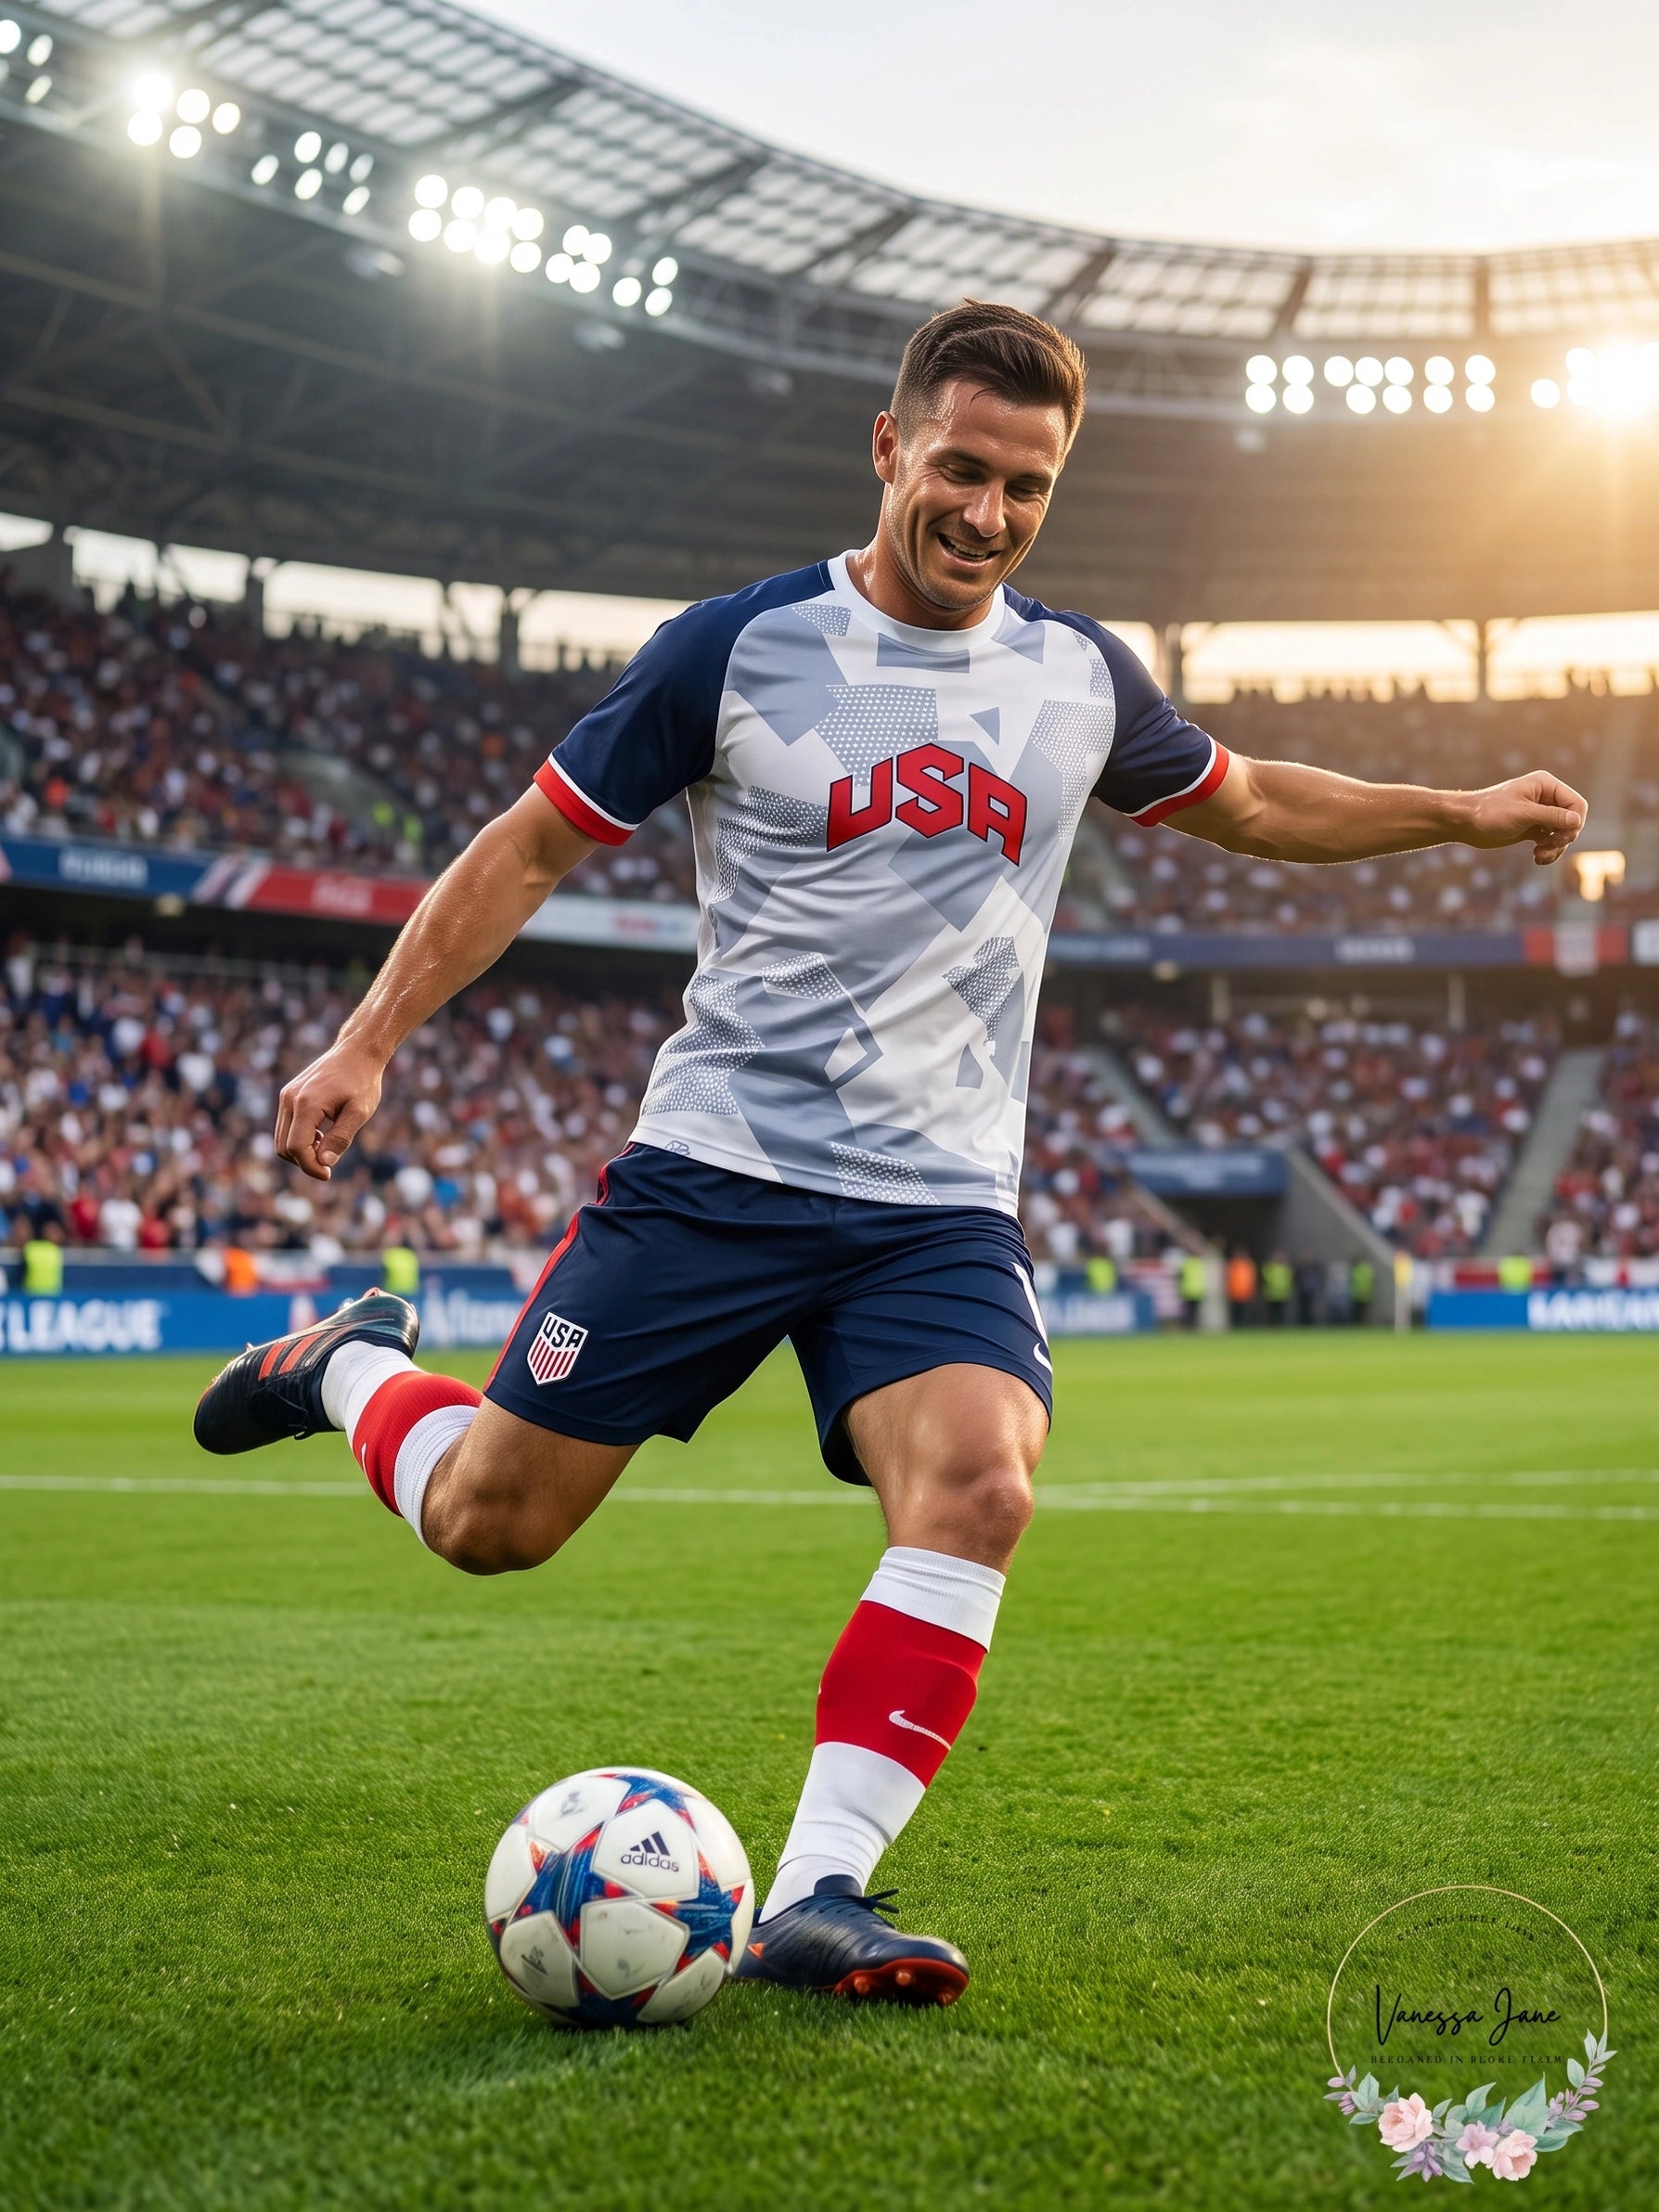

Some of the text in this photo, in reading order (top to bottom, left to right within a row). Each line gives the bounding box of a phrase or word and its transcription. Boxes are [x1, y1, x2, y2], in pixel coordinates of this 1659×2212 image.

[826, 742, 1027, 867] USA
[7, 1299, 161, 1352] LEAGUE
[543, 1317, 584, 1348] USA
[620, 1852, 679, 1872] adidas
